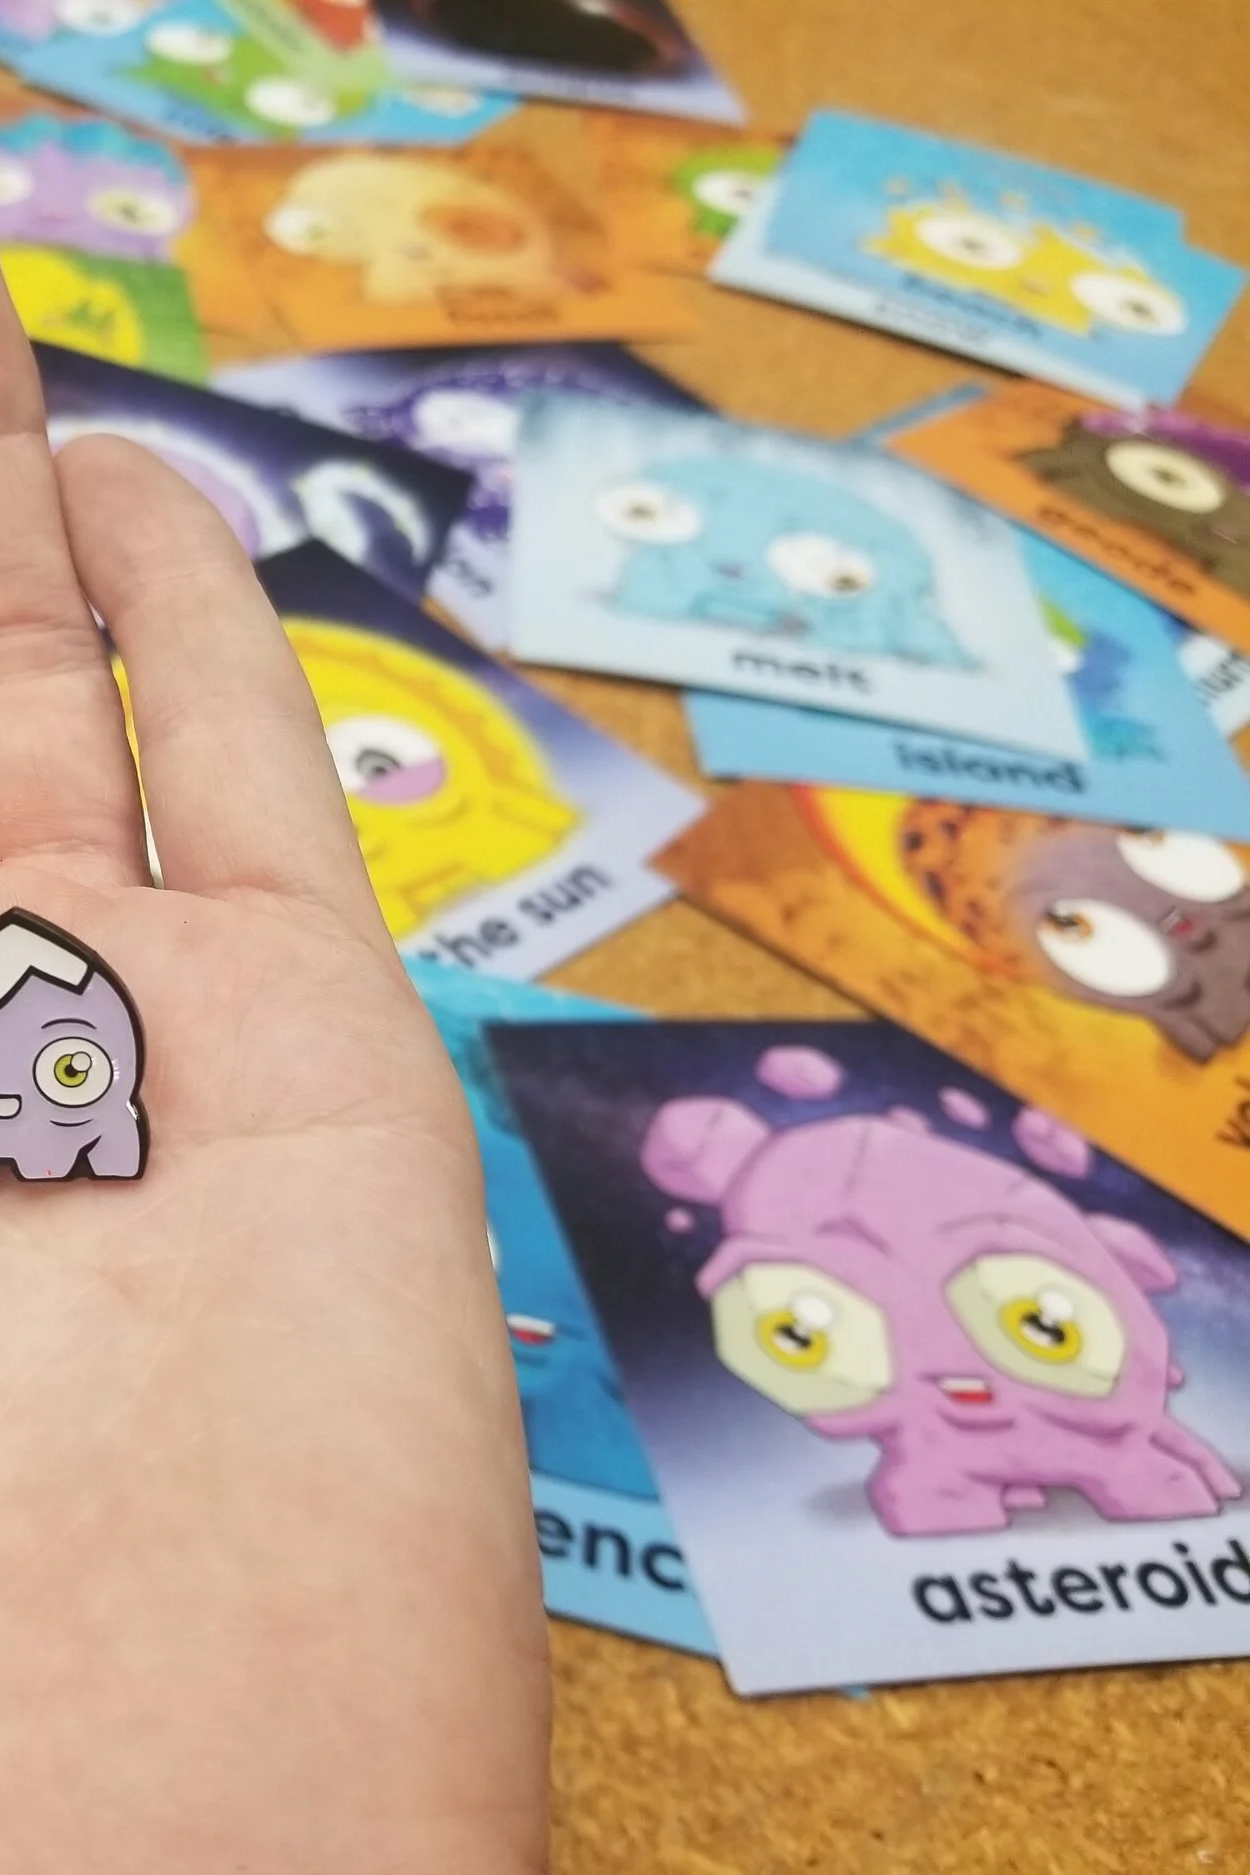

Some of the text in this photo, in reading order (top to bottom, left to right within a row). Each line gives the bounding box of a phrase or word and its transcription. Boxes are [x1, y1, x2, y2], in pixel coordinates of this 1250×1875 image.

[733, 651, 872, 694] melt
[894, 737, 1087, 795] island
[518, 866, 613, 926] sun
[911, 1539, 1250, 1625] asteroid
